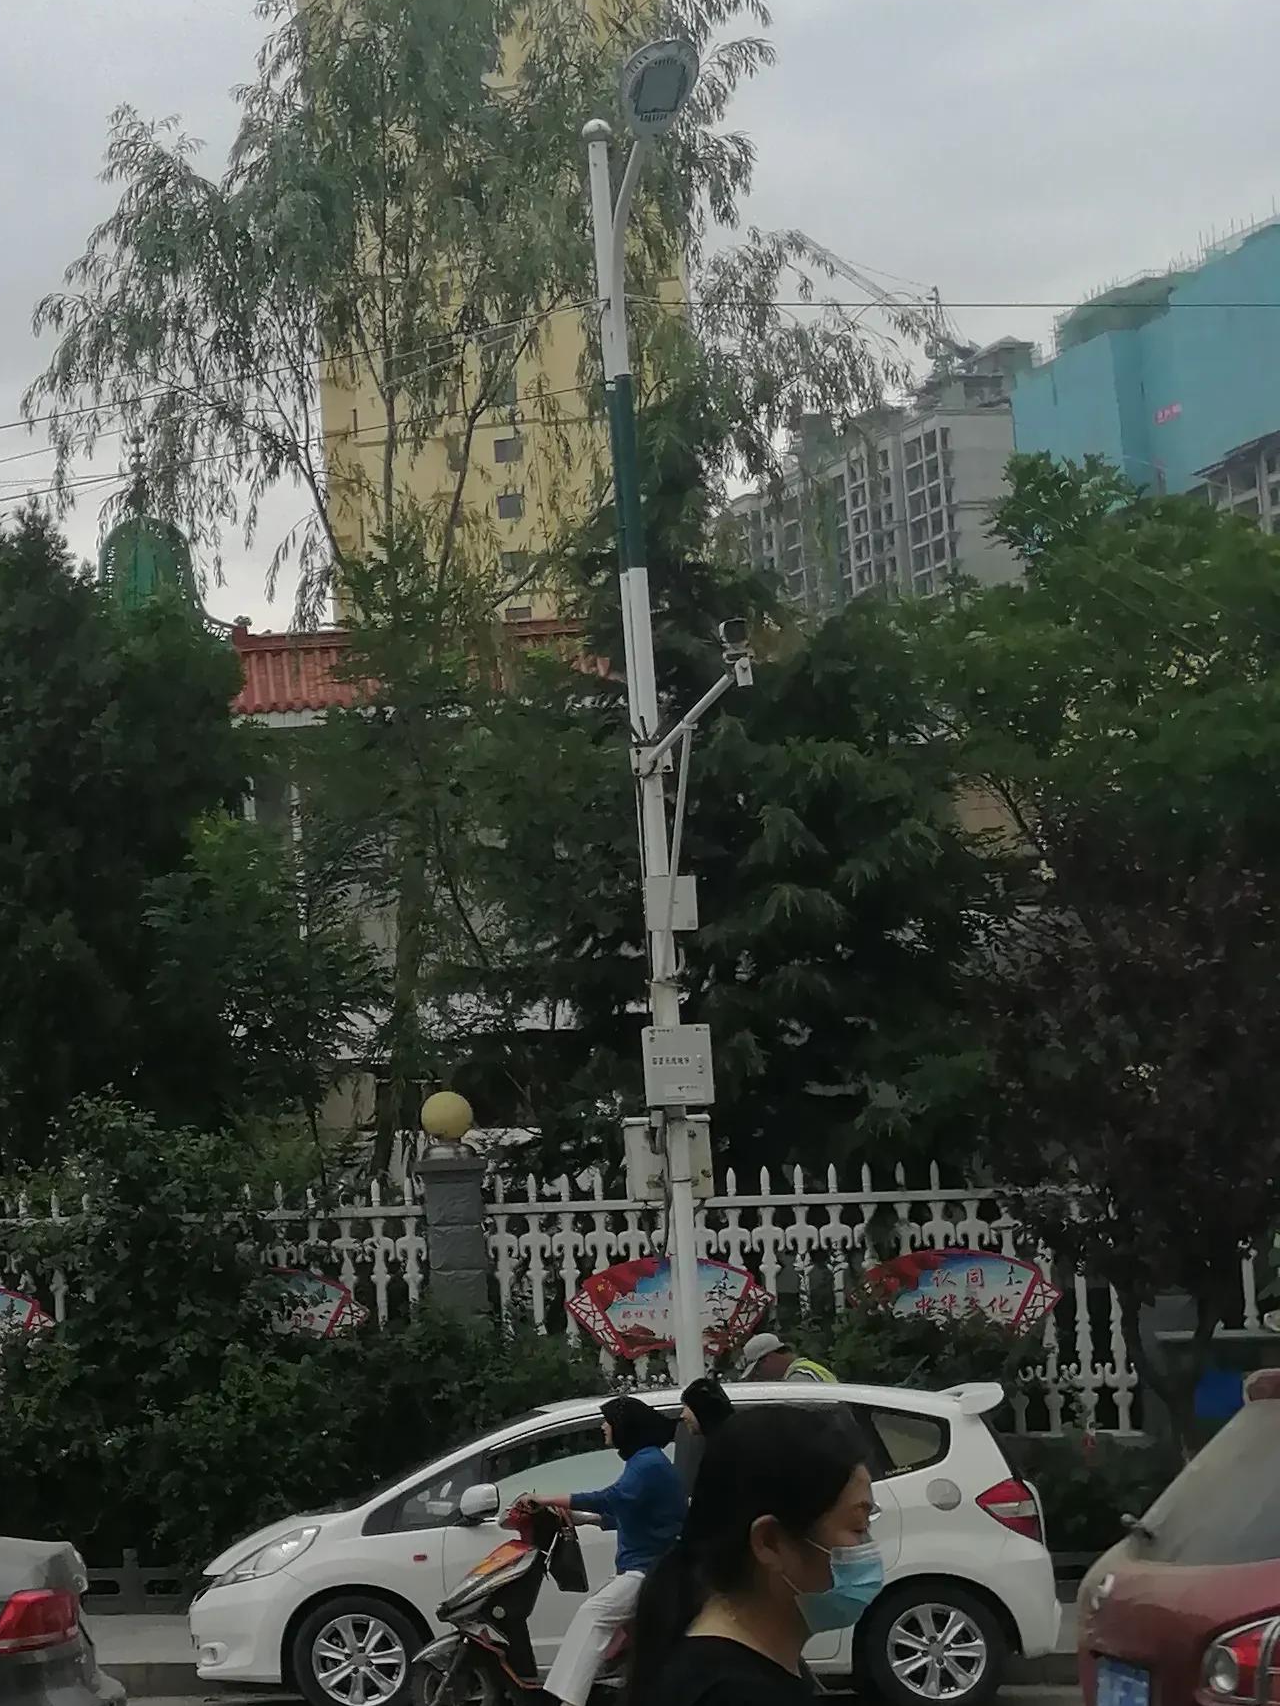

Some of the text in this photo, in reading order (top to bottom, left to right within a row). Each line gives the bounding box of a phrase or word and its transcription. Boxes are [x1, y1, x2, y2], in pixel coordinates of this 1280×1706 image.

[931, 1267, 985, 1288] 认同
[914, 1294, 1011, 1313] 中华文化
